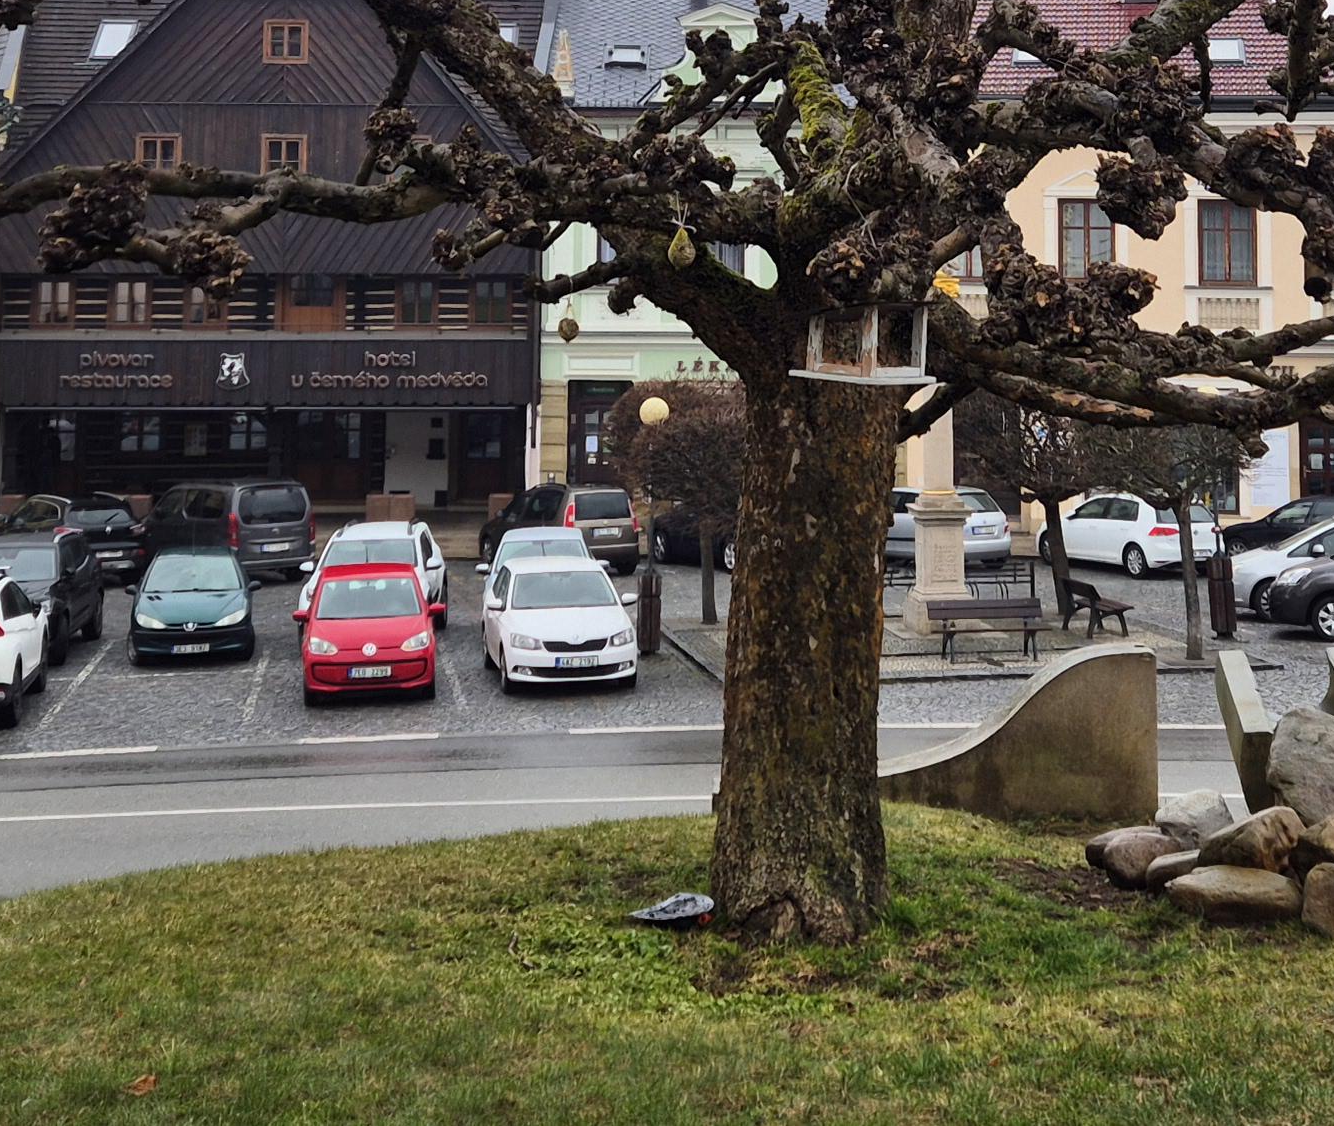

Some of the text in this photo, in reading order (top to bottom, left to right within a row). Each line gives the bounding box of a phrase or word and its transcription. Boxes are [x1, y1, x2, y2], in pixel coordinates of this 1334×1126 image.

[79, 350, 155, 370] pivovar
[364, 350, 417, 367] hotel
[59, 372, 174, 388] restaurace
[291, 373, 305, 388] u
[396, 371, 489, 388] medvěda
